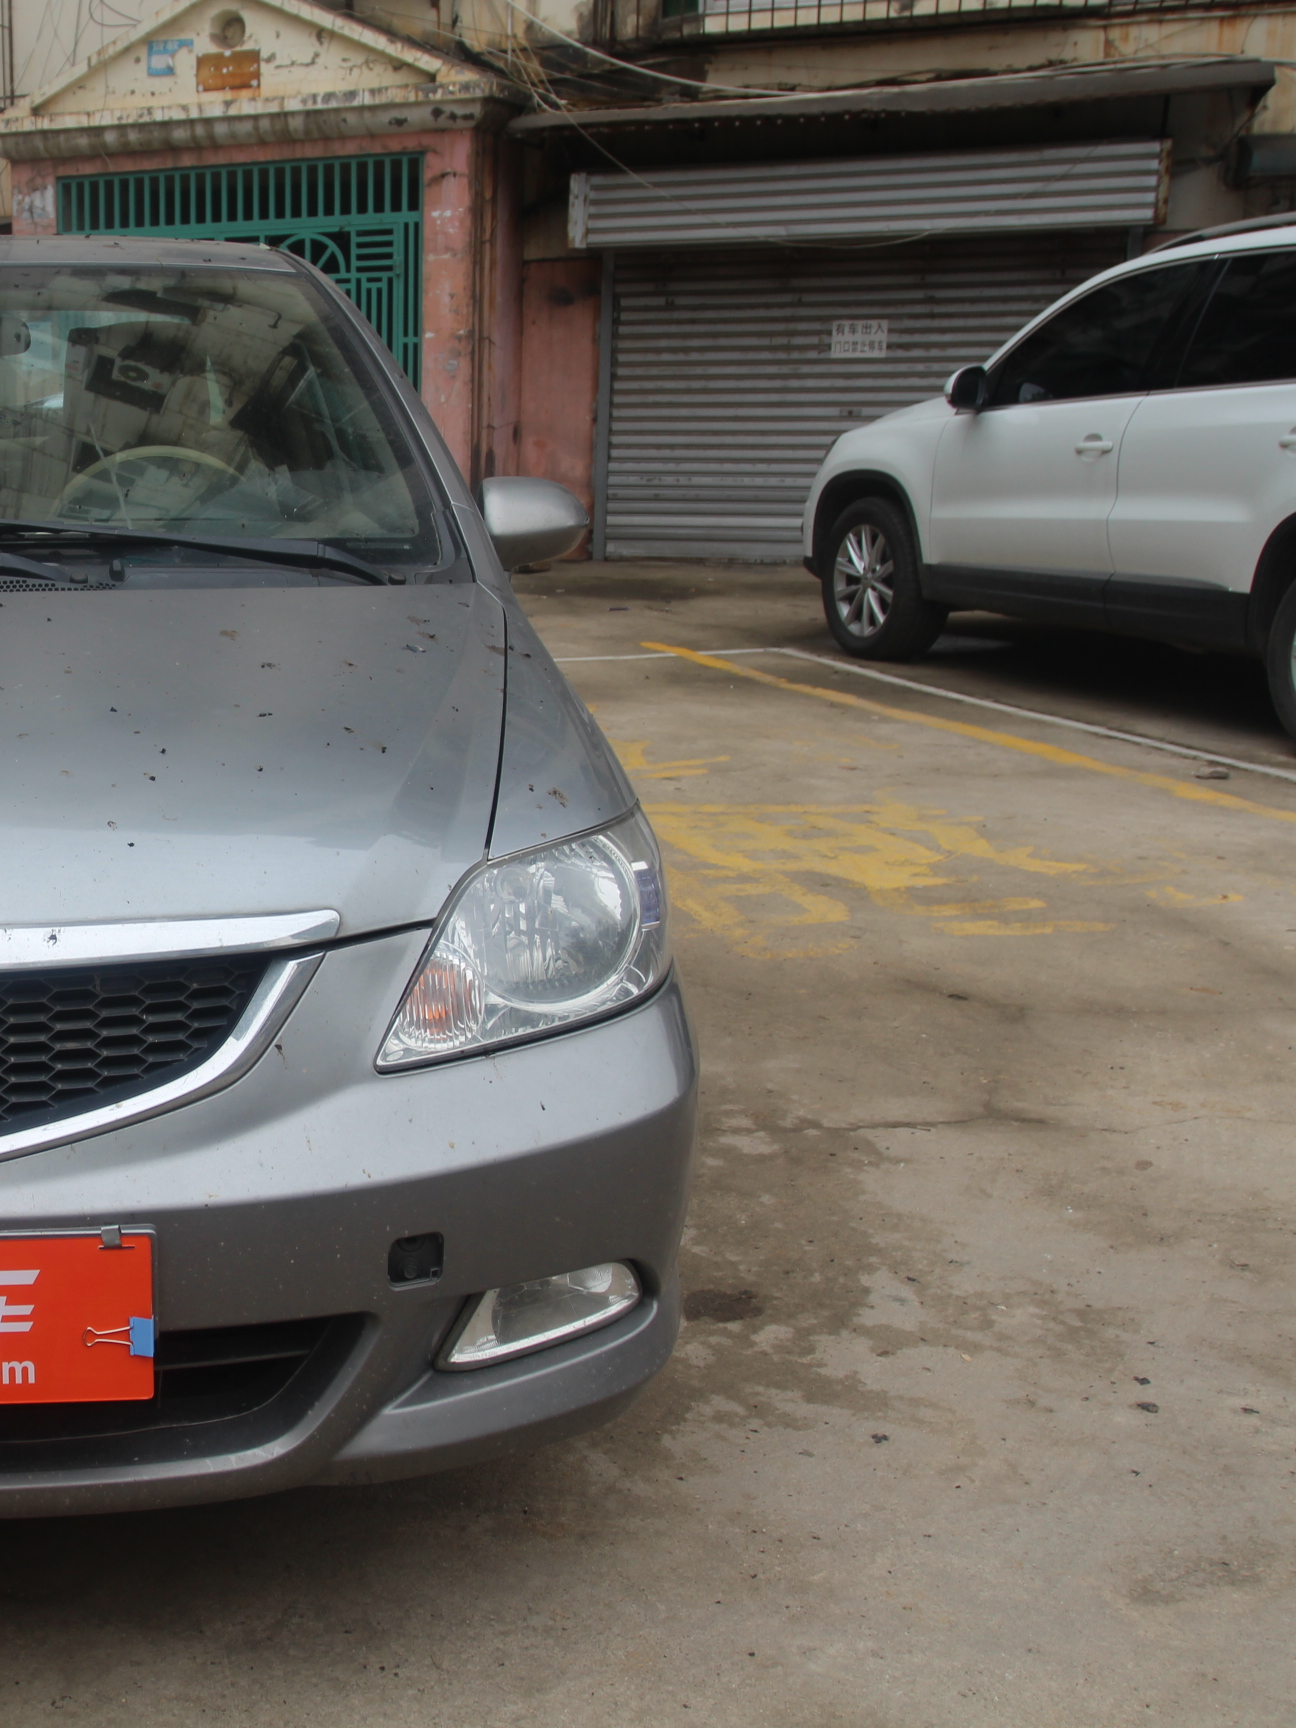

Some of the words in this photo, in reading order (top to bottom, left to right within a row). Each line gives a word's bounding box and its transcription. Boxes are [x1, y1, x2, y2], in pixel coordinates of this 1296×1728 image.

[835, 322, 885, 336] 有车出入
[834, 340, 884, 354] 门口禁止停车
